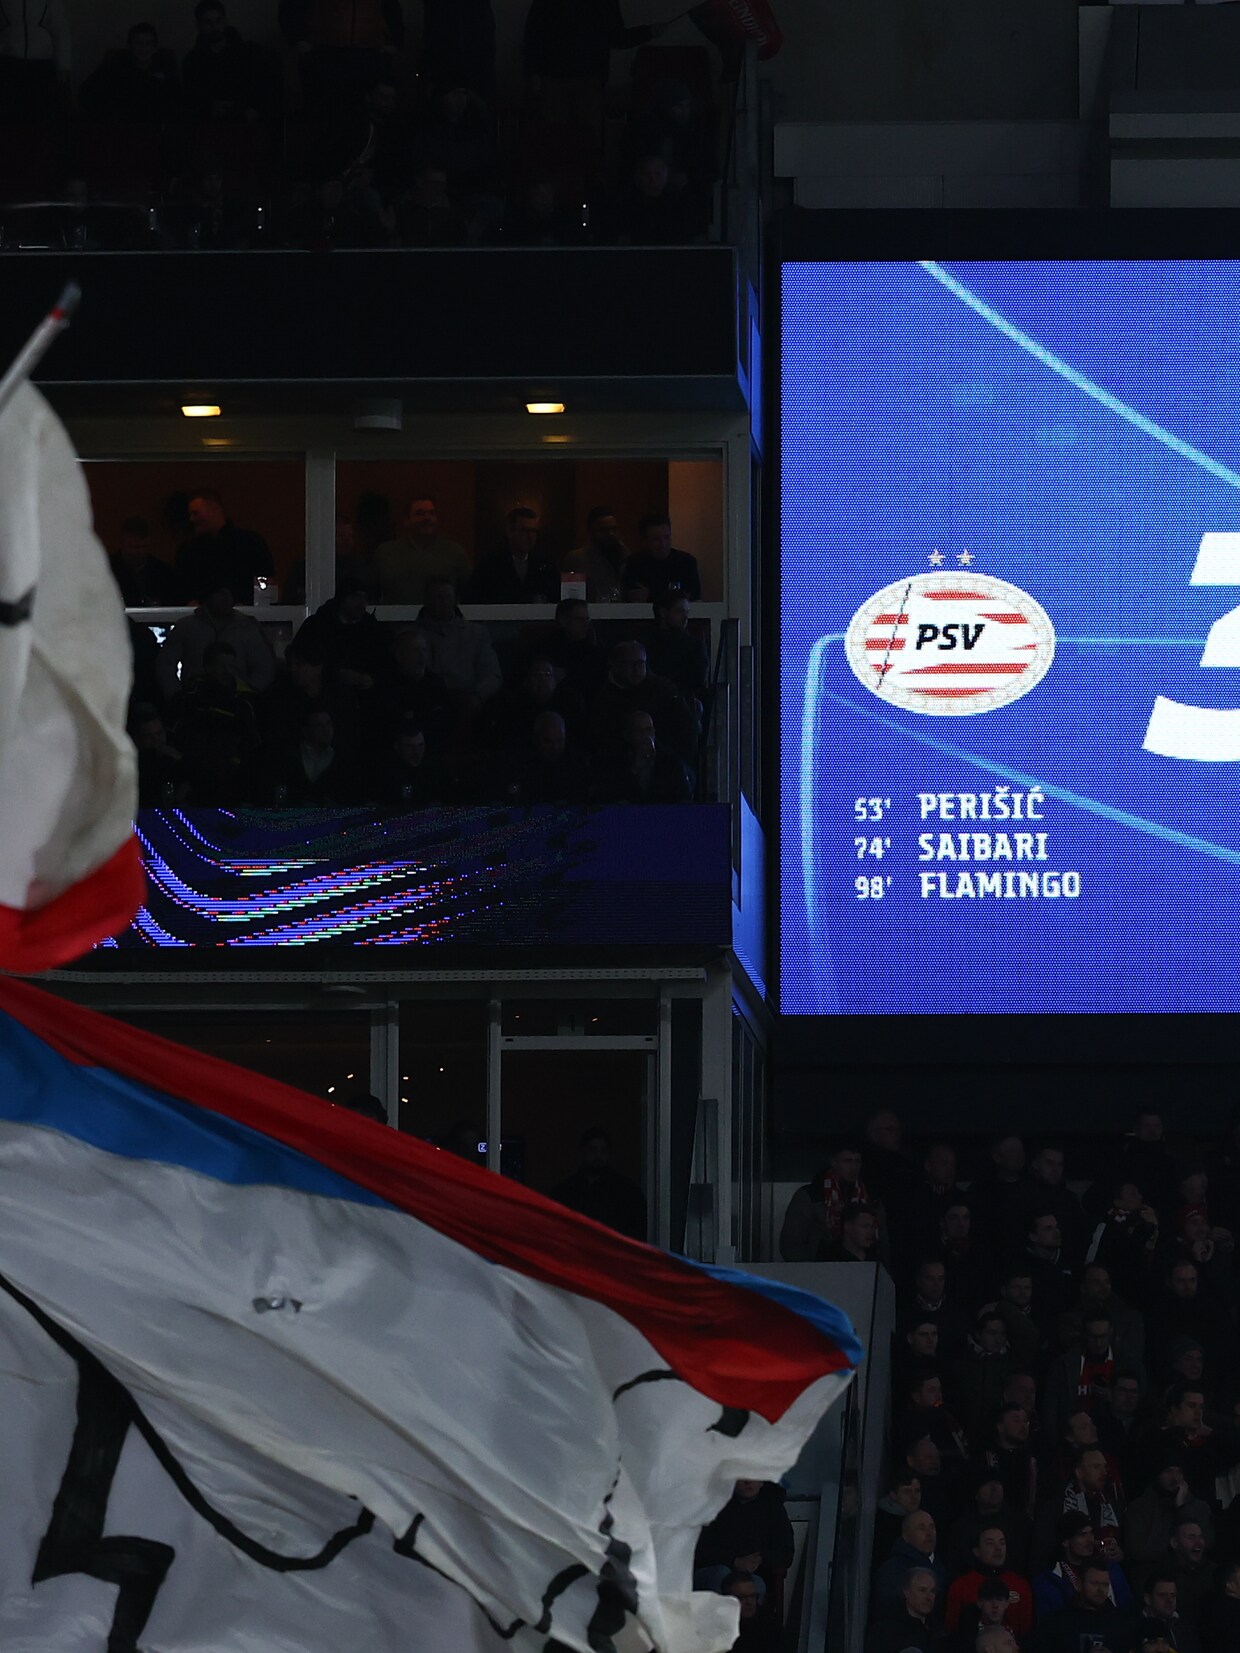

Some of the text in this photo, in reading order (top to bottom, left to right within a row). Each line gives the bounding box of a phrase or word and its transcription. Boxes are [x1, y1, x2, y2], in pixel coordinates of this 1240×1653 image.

[916, 623, 985, 651] PSV
[854, 786, 1046, 821] 53' PERIŠIĆ
[854, 833, 1049, 861] 74' SAIBARI
[854, 871, 1082, 900] 98' FLAMINGO
